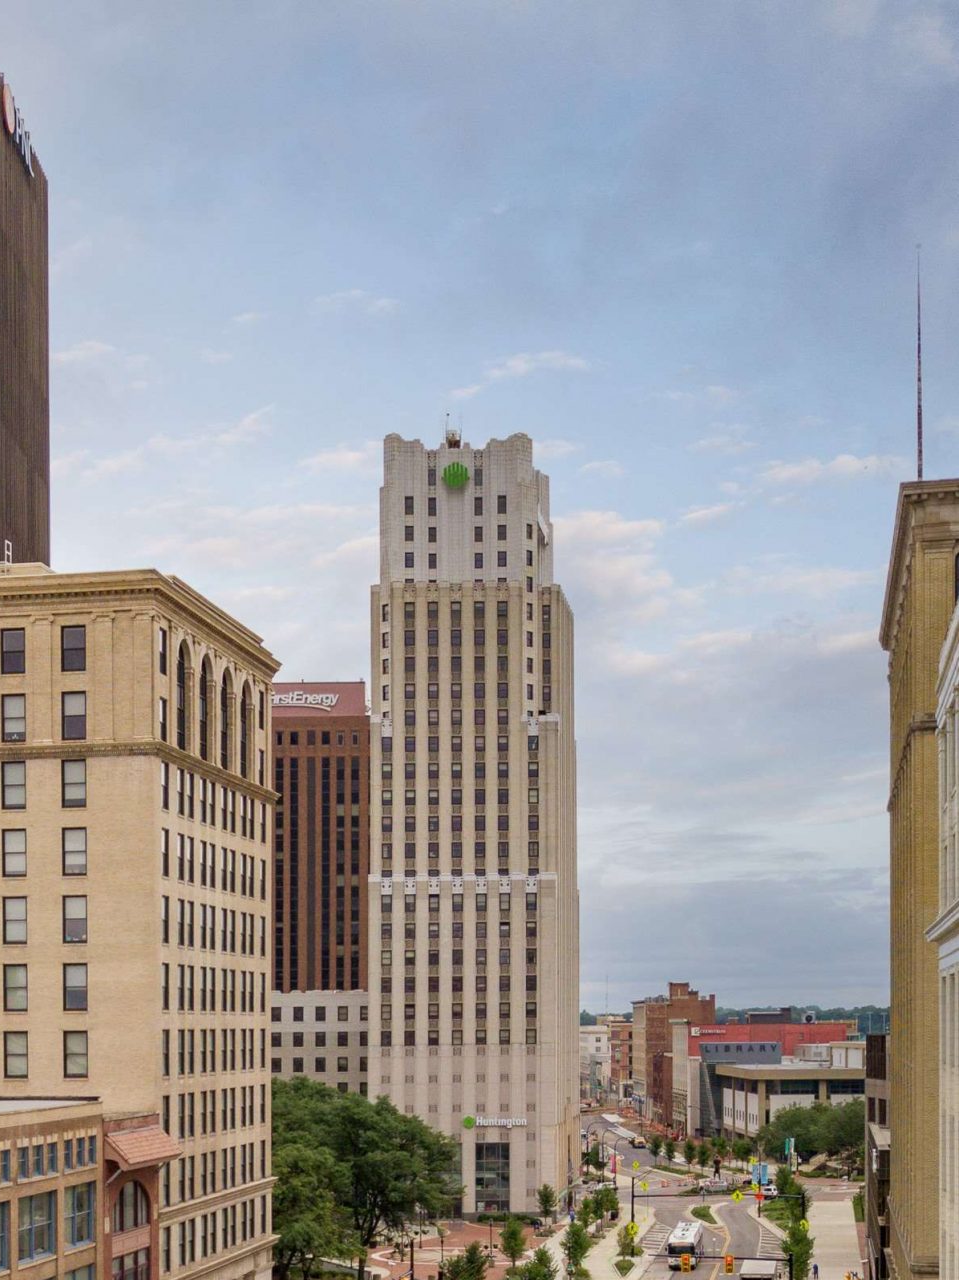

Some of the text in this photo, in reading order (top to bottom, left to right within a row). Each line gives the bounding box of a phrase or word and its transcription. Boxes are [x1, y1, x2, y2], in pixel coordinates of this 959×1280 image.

[272, 691, 339, 706] irstEnergy
[704, 1044, 777, 1053] LIBRARY
[476, 1116, 527, 1129] Huntington
